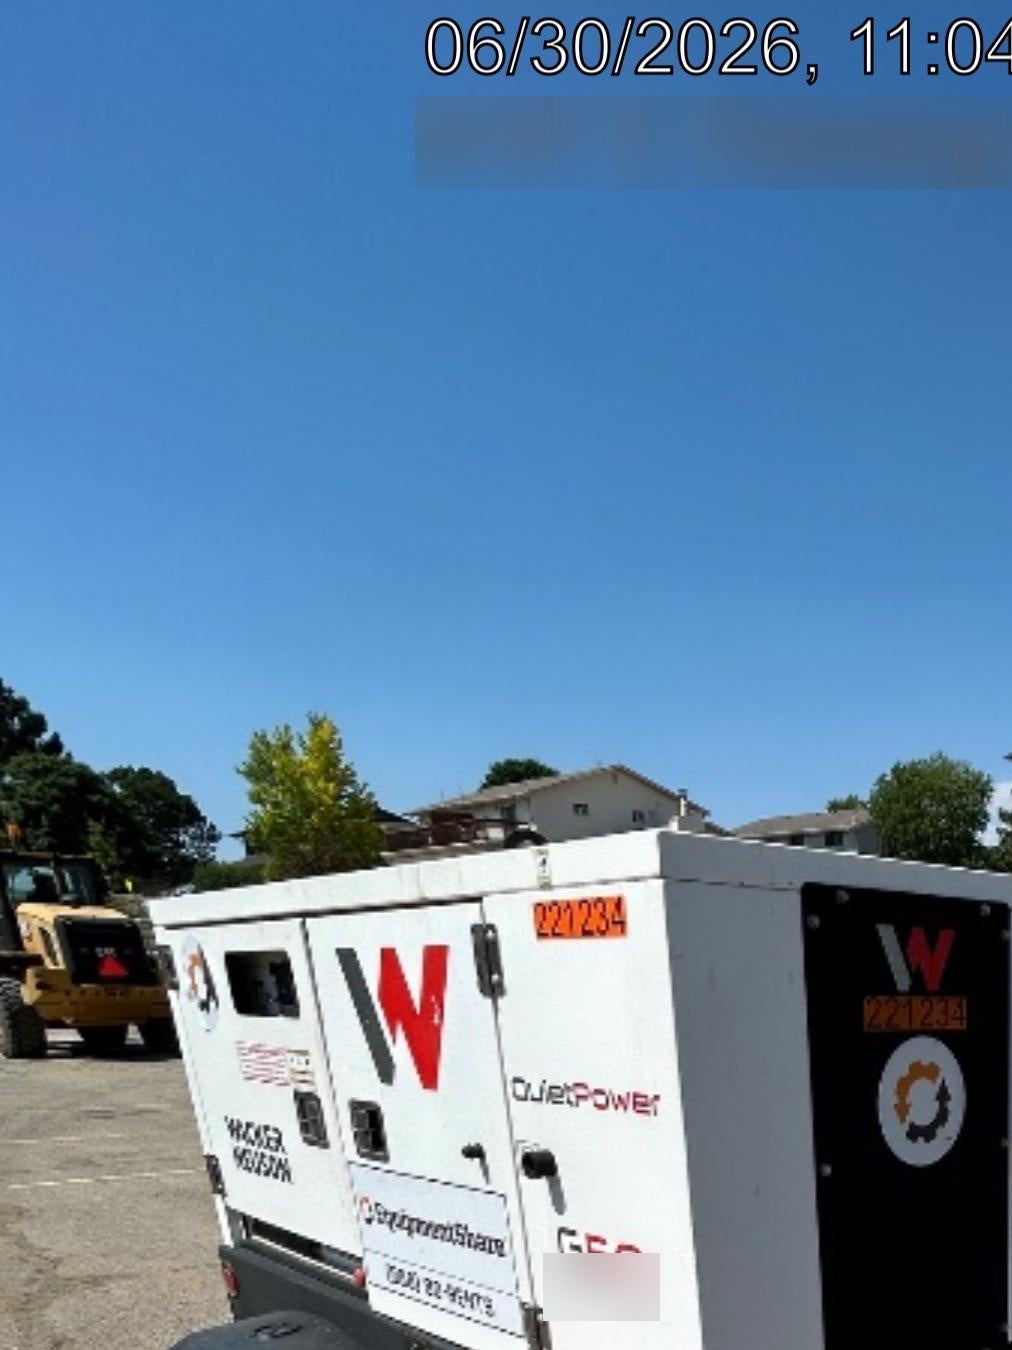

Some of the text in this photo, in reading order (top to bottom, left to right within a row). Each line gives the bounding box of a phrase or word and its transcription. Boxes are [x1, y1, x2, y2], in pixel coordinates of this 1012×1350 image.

[534, 896, 626, 939] 221234
[866, 997, 967, 1029] 221234
[511, 1075, 661, 1117] QuietPower
